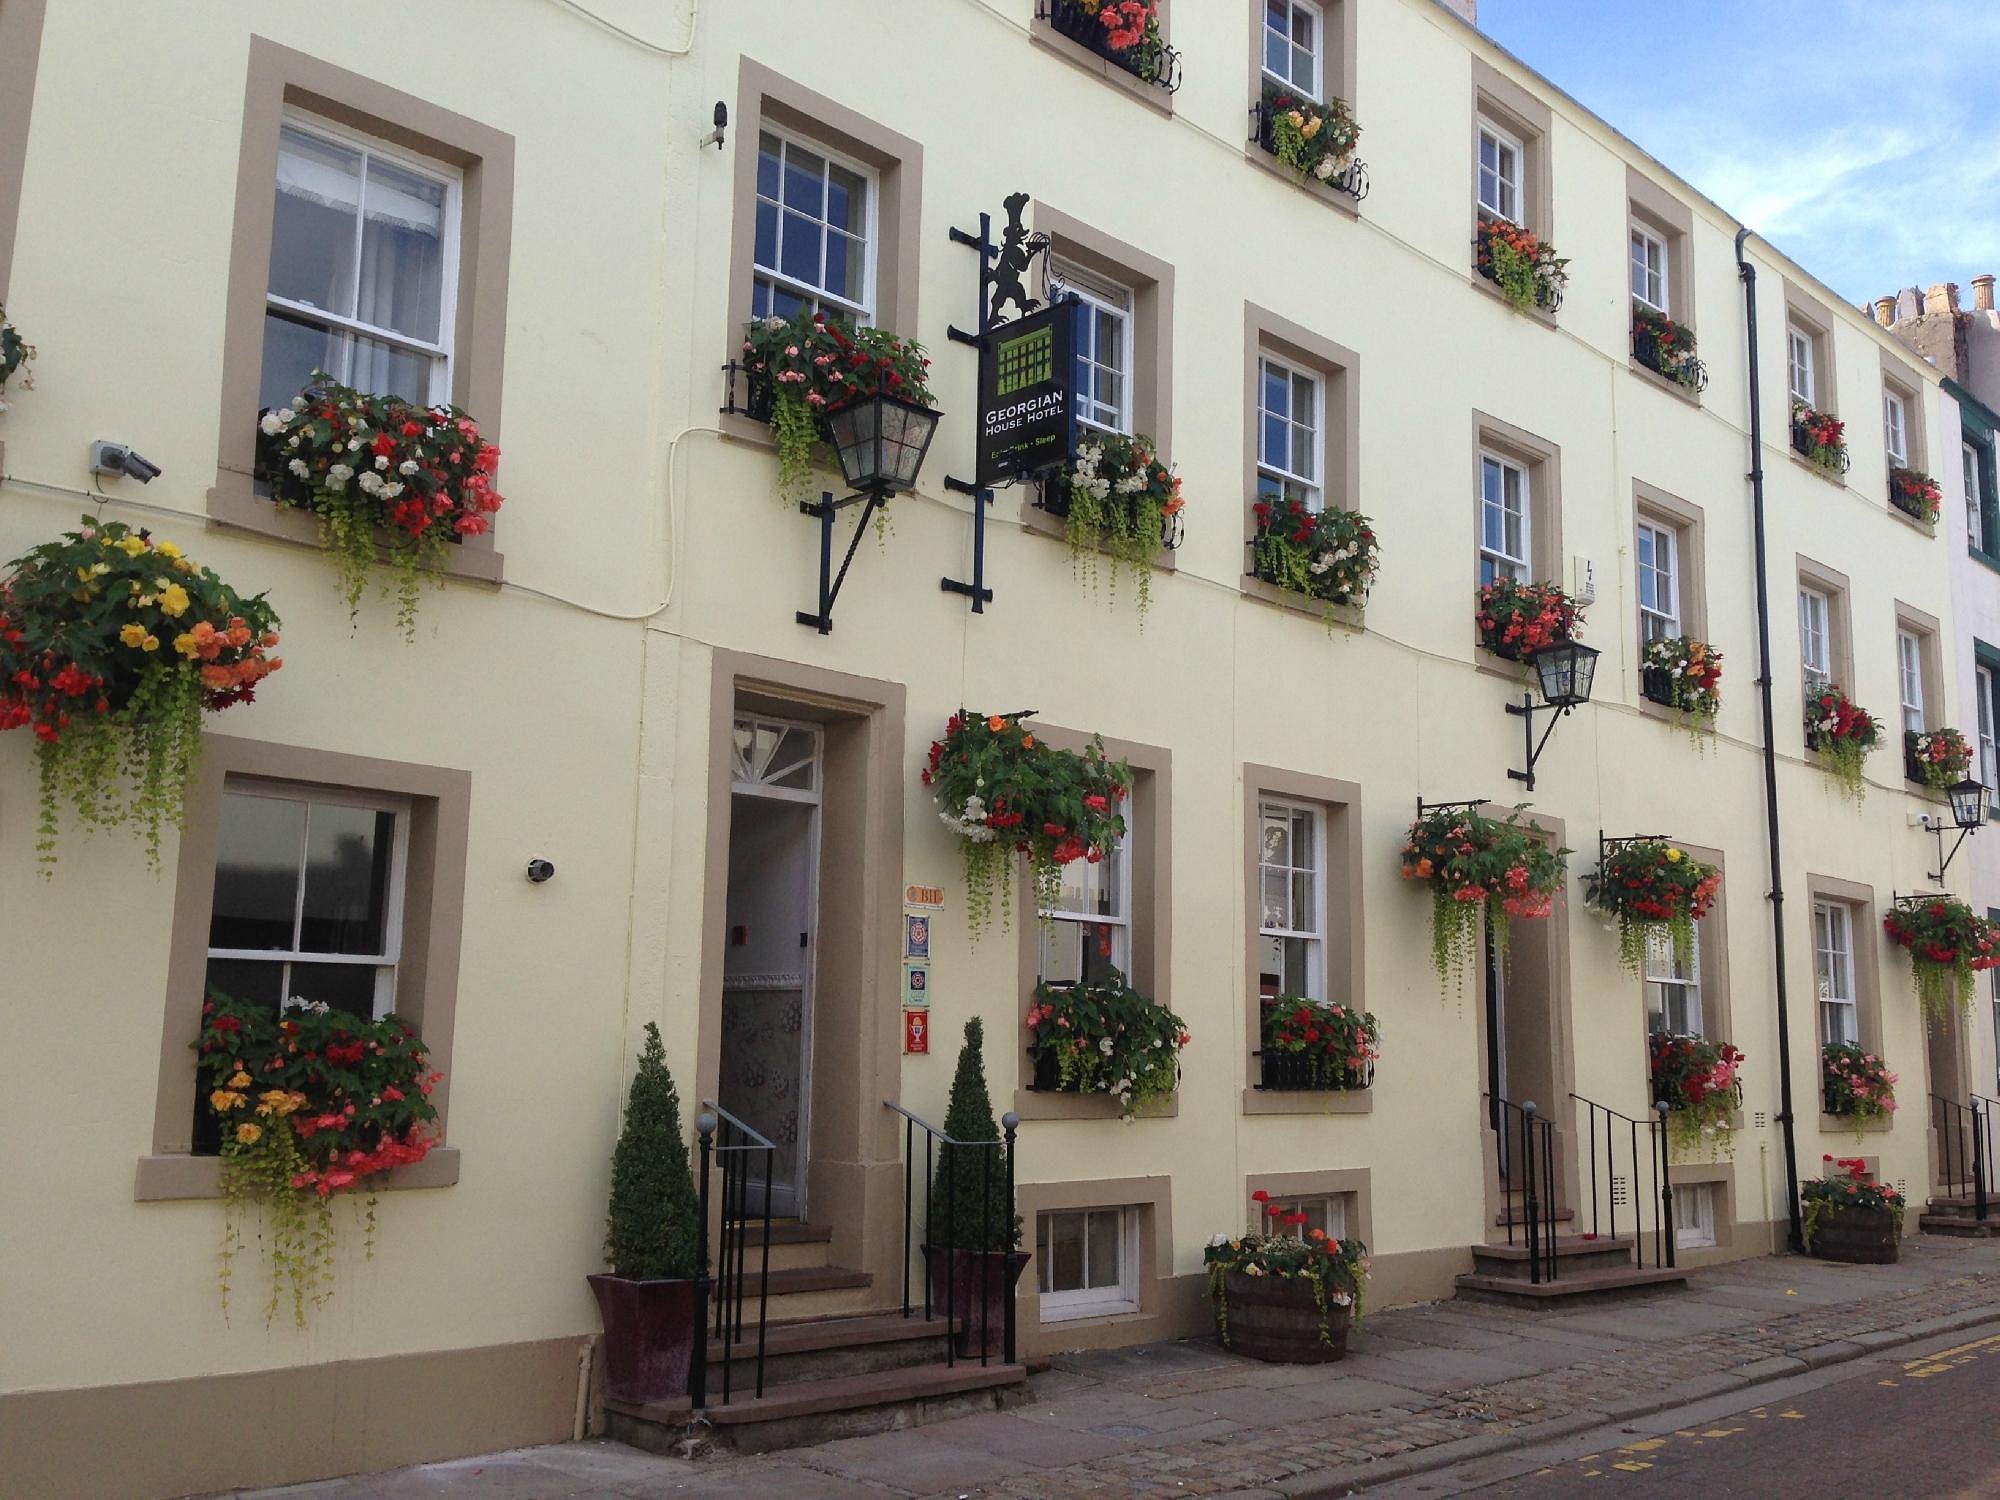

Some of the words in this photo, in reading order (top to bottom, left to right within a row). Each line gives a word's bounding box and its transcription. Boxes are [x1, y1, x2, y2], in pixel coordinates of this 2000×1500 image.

[985, 418, 1023, 437] HOUSE
[1027, 405, 1064, 423] HOTEL
[986, 390, 1063, 425] GEORGIAN
[1035, 434, 1056, 446] Sleep
